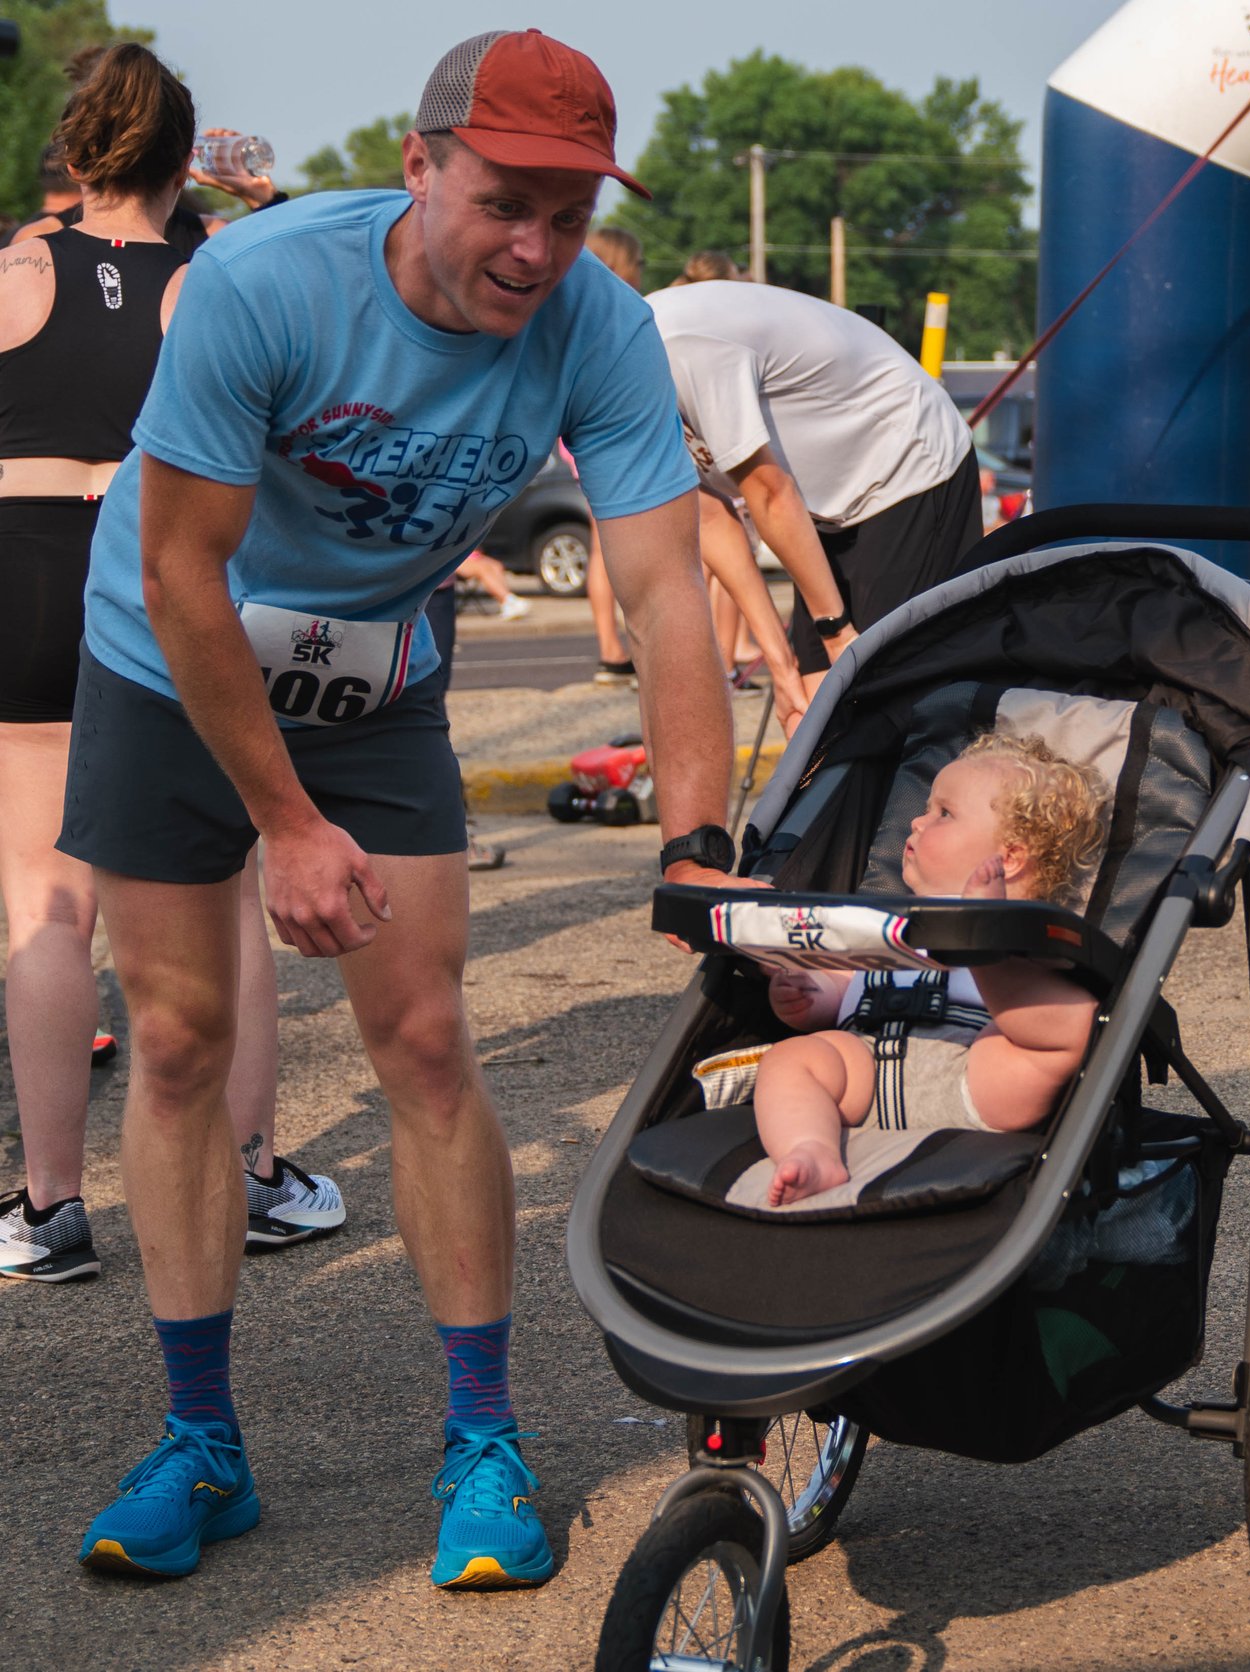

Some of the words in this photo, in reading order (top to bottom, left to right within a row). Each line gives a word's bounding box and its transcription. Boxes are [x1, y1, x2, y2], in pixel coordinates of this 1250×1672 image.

[291, 643, 336, 666] 5K
[261, 667, 372, 723] 06
[787, 931, 829, 951] 5K
